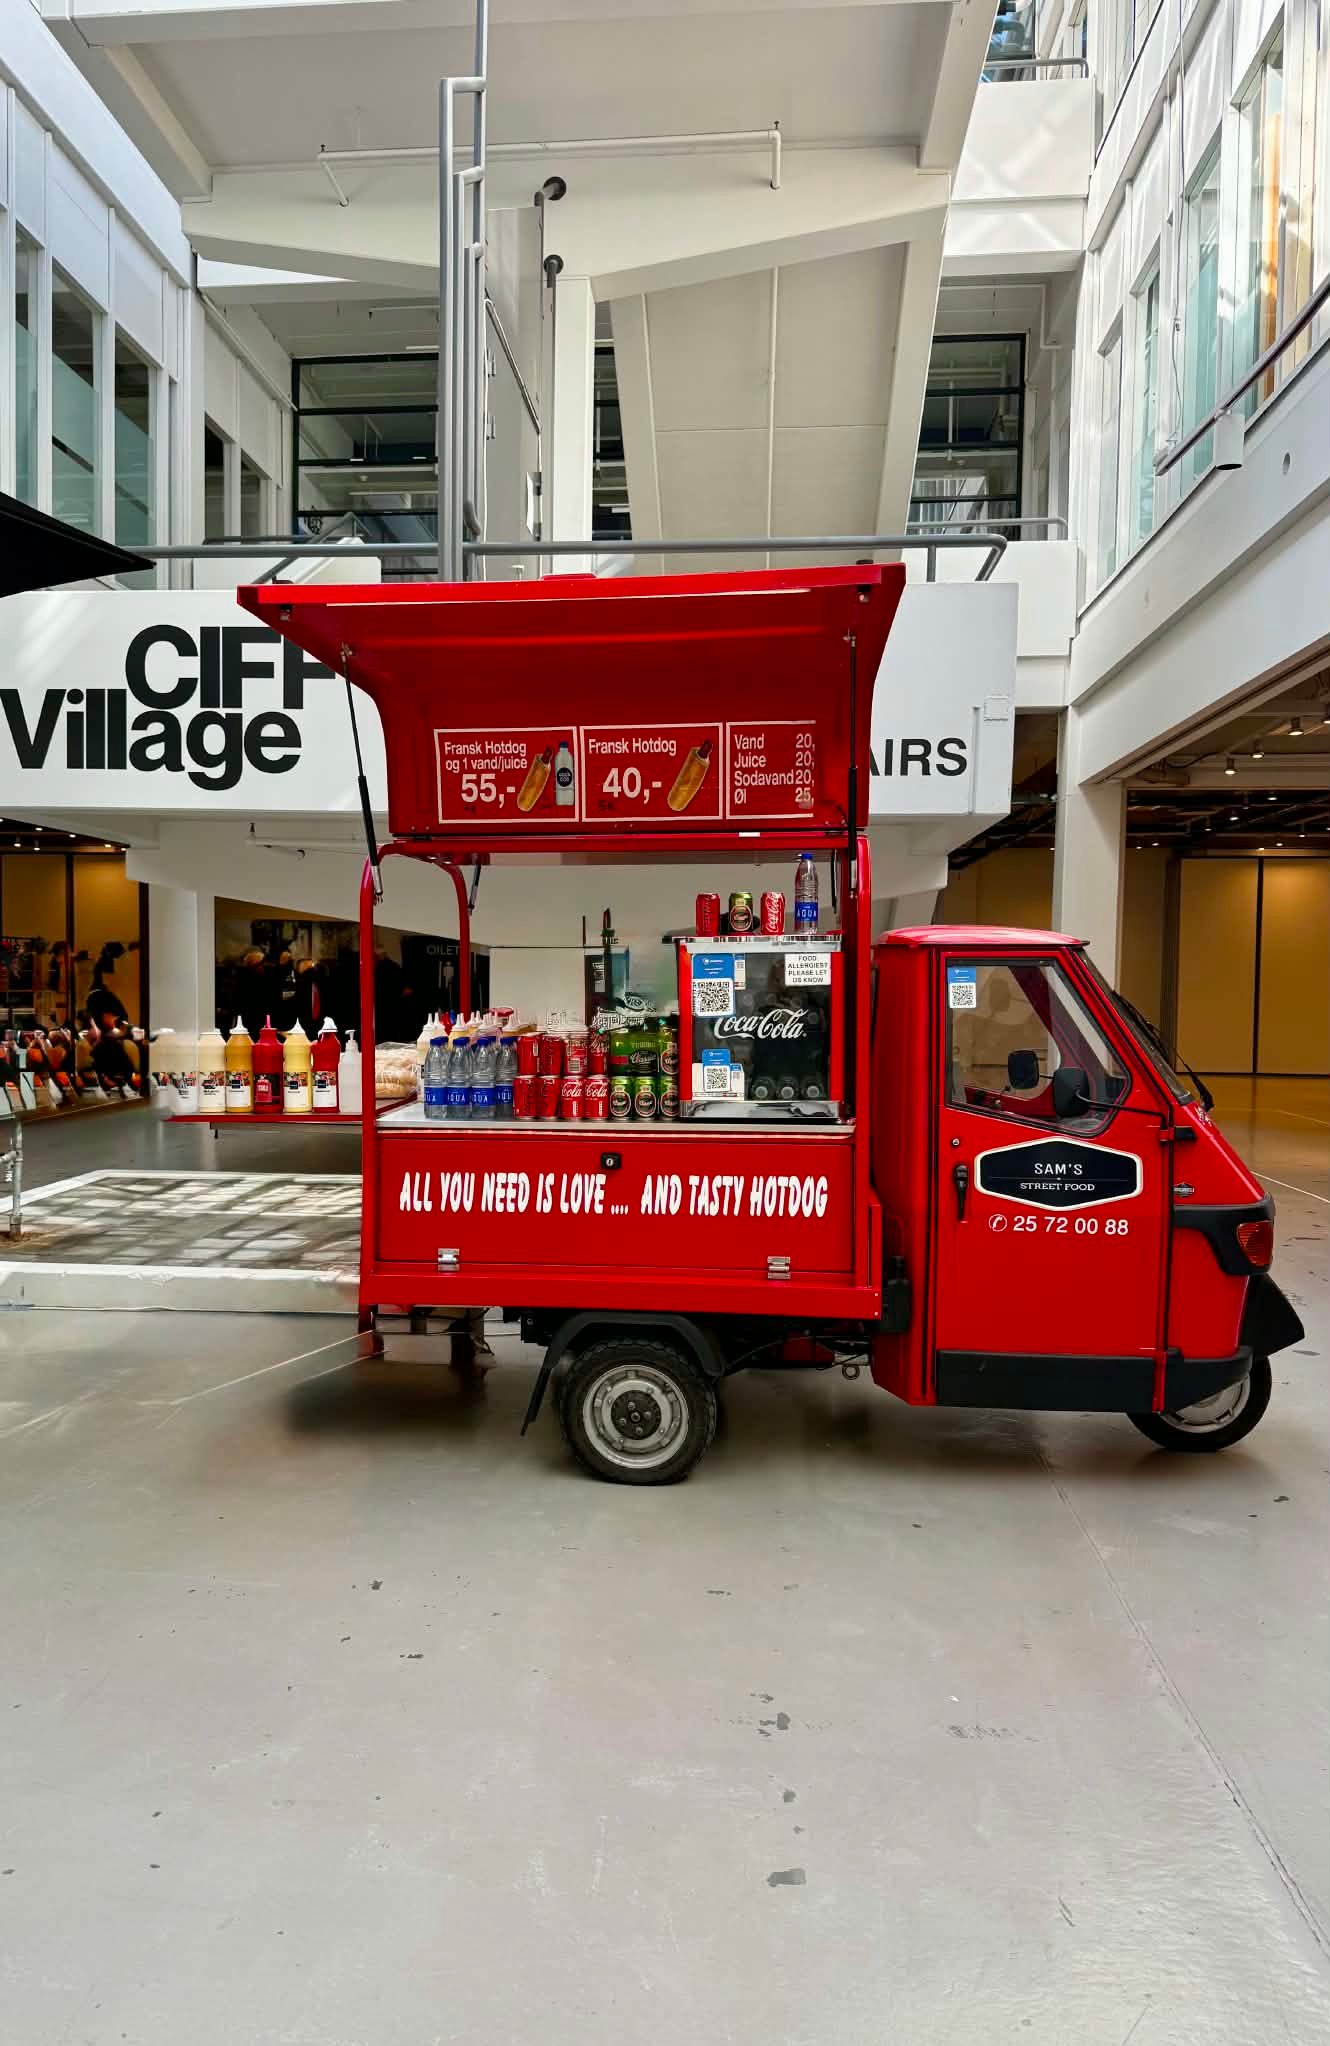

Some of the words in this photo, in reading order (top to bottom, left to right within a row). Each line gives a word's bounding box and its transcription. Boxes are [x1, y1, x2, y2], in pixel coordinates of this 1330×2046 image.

[125, 624, 336, 710] CIFF
[0, 688, 302, 791] Village
[444, 741, 482, 756] Fransk
[485, 740, 526, 756] Hotdog
[588, 738, 629, 754] Fransk
[632, 737, 677, 756] Hotdog
[734, 733, 764, 750] Vand
[445, 759, 460, 773] og
[462, 758, 468, 770] 1
[471, 756, 528, 772] vand/juice
[734, 752, 767, 768] Juice
[602, 767, 662, 804] 40,-
[734, 770, 794, 786] Sodavand
[461, 773, 516, 808] 55,-
[734, 788, 747, 805] Øl
[1034, 1163, 1083, 1175] SAM'S
[400, 1172, 432, 1212] ALL
[440, 1172, 475, 1212] YOU
[481, 1172, 530, 1213] NEED
[536, 1173, 554, 1214] IS
[560, 1173, 606, 1214] LOVE
[641, 1174, 682, 1216] AND
[688, 1175, 744, 1216] TASTY
[750, 1176, 828, 1217] HOTDOG
[1020, 1182, 1062, 1191] STREET
[1065, 1182, 1095, 1191] FOOD
[1013, 1216, 1037, 1232] 25
[1044, 1216, 1068, 1233] 72
[1074, 1218, 1099, 1234] 00
[1104, 1219, 1129, 1235] 88
